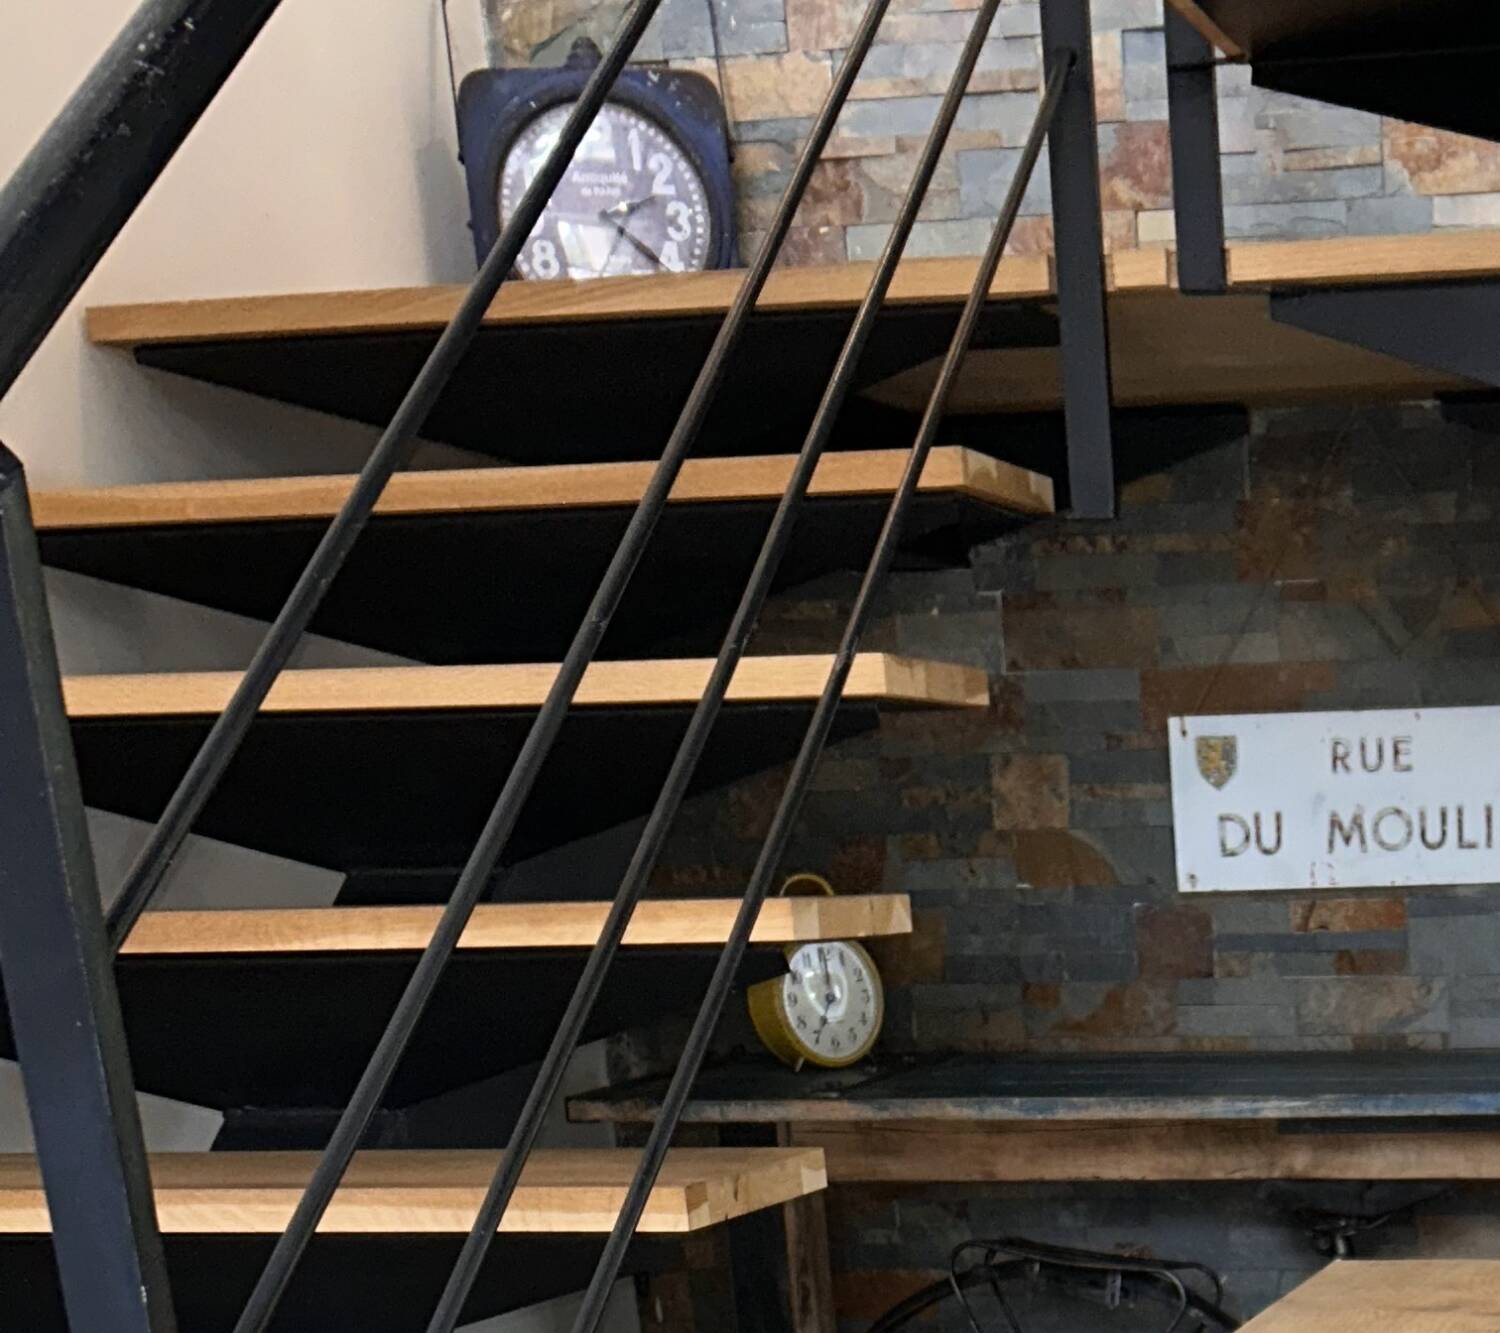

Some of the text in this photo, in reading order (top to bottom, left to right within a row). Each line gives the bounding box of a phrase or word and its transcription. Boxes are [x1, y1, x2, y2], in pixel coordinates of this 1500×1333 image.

[628, 127, 642, 171] 1
[648, 153, 676, 195] 2
[666, 201, 691, 241] 3
[531, 239, 560, 279] 8
[1330, 735, 1414, 774] RUE
[1218, 810, 1283, 858] DU
